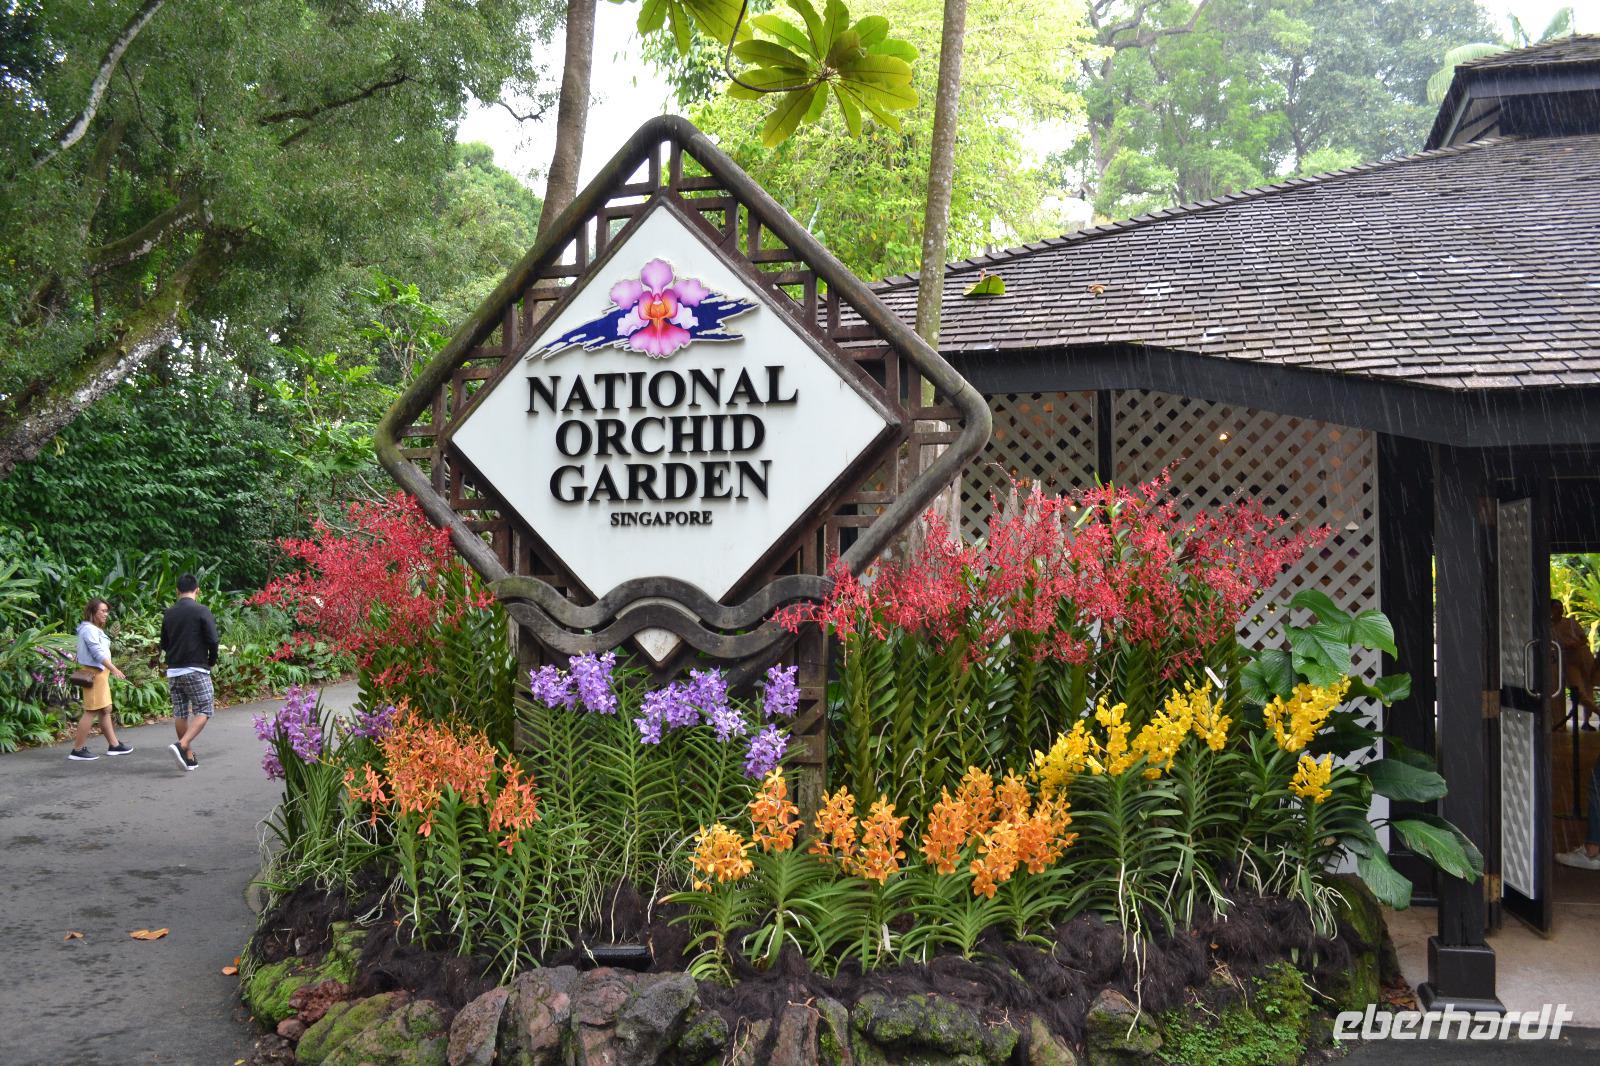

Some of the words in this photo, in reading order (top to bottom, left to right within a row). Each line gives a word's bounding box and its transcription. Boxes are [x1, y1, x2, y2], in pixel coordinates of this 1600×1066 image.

[526, 365, 799, 414] NATIONAL
[555, 413, 765, 457] ORCHID
[549, 459, 772, 504] GARDEN
[610, 510, 713, 527] SINGAPORE
